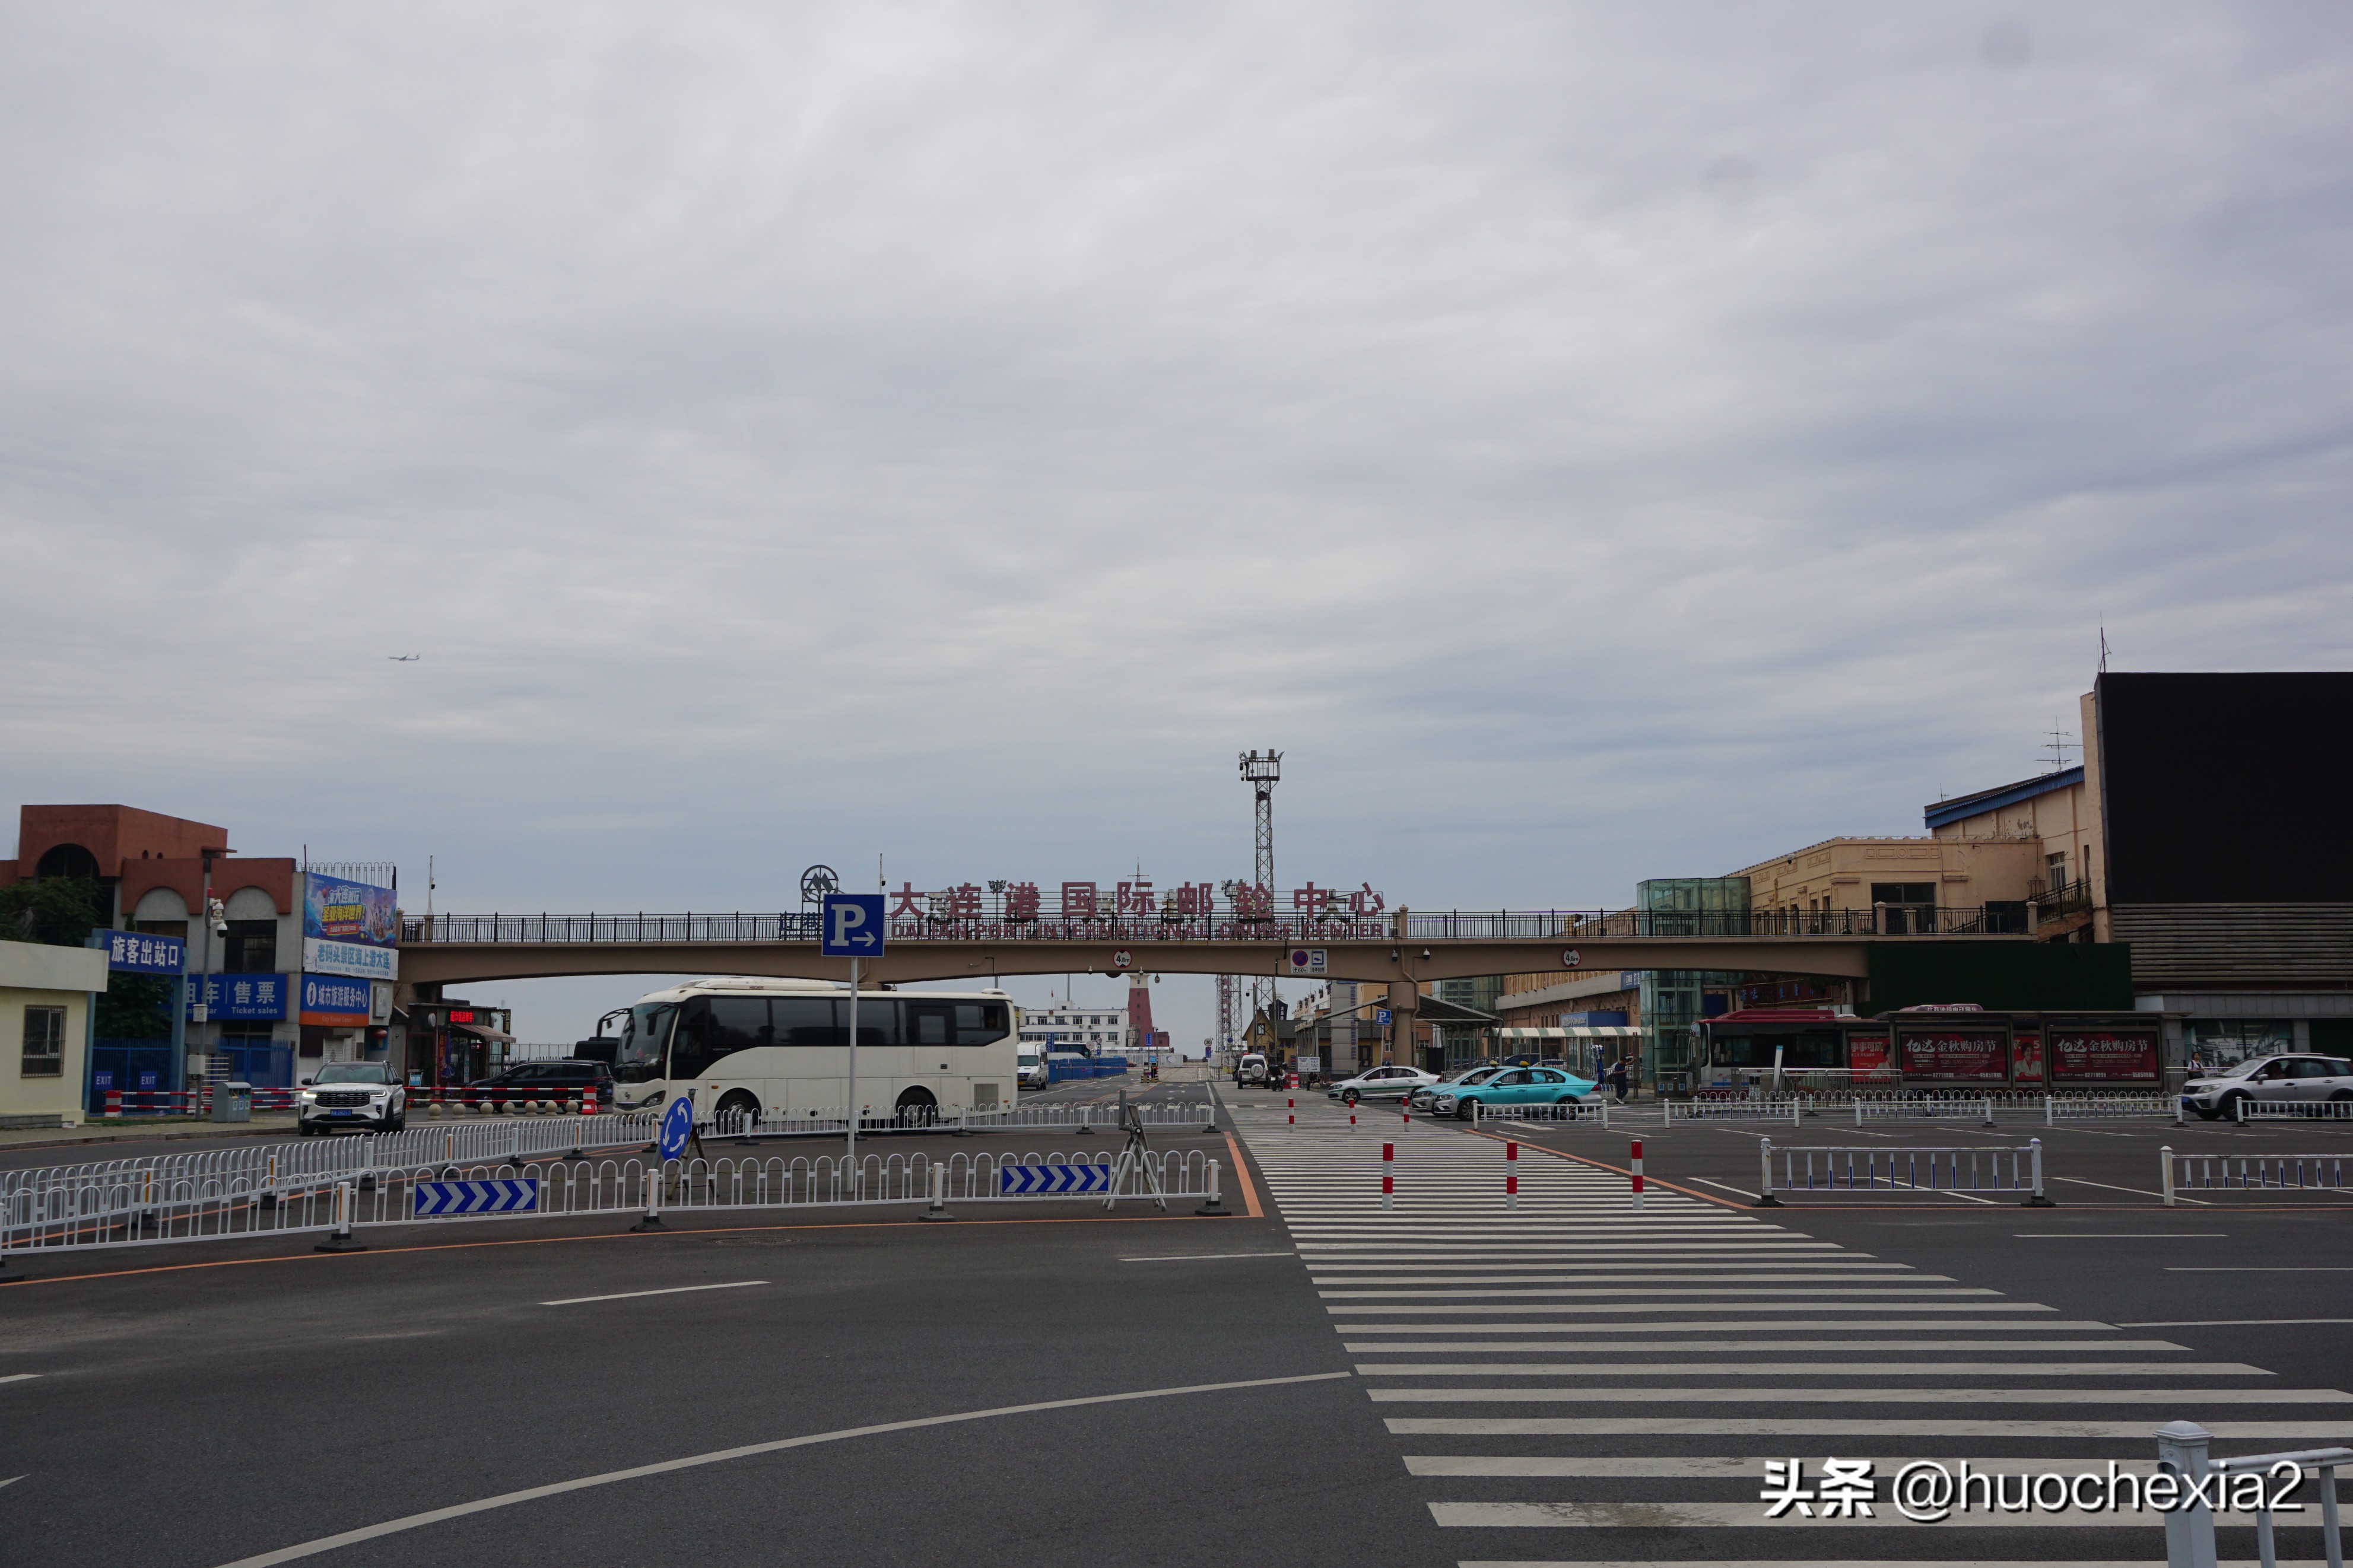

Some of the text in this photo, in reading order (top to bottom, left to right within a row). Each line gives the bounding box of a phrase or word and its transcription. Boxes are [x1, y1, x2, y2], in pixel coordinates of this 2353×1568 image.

[889, 882, 1385, 919] 大连港国际邮轮中心
[830, 904, 866, 946] P
[891, 923, 1383, 938] DALIAN PORT INTERNATIONAL CRUISE CENTER
[111, 936, 178, 967] 旅客出站口
[317, 943, 390, 969] 老码头景区海上游大连
[234, 981, 275, 1004] 售票
[318, 984, 367, 1008] 城市旅游服务中心
[1377, 1012, 1387, 1022] P
[96, 1076, 112, 1084] EXIT
[141, 1076, 155, 1084] EXIT
